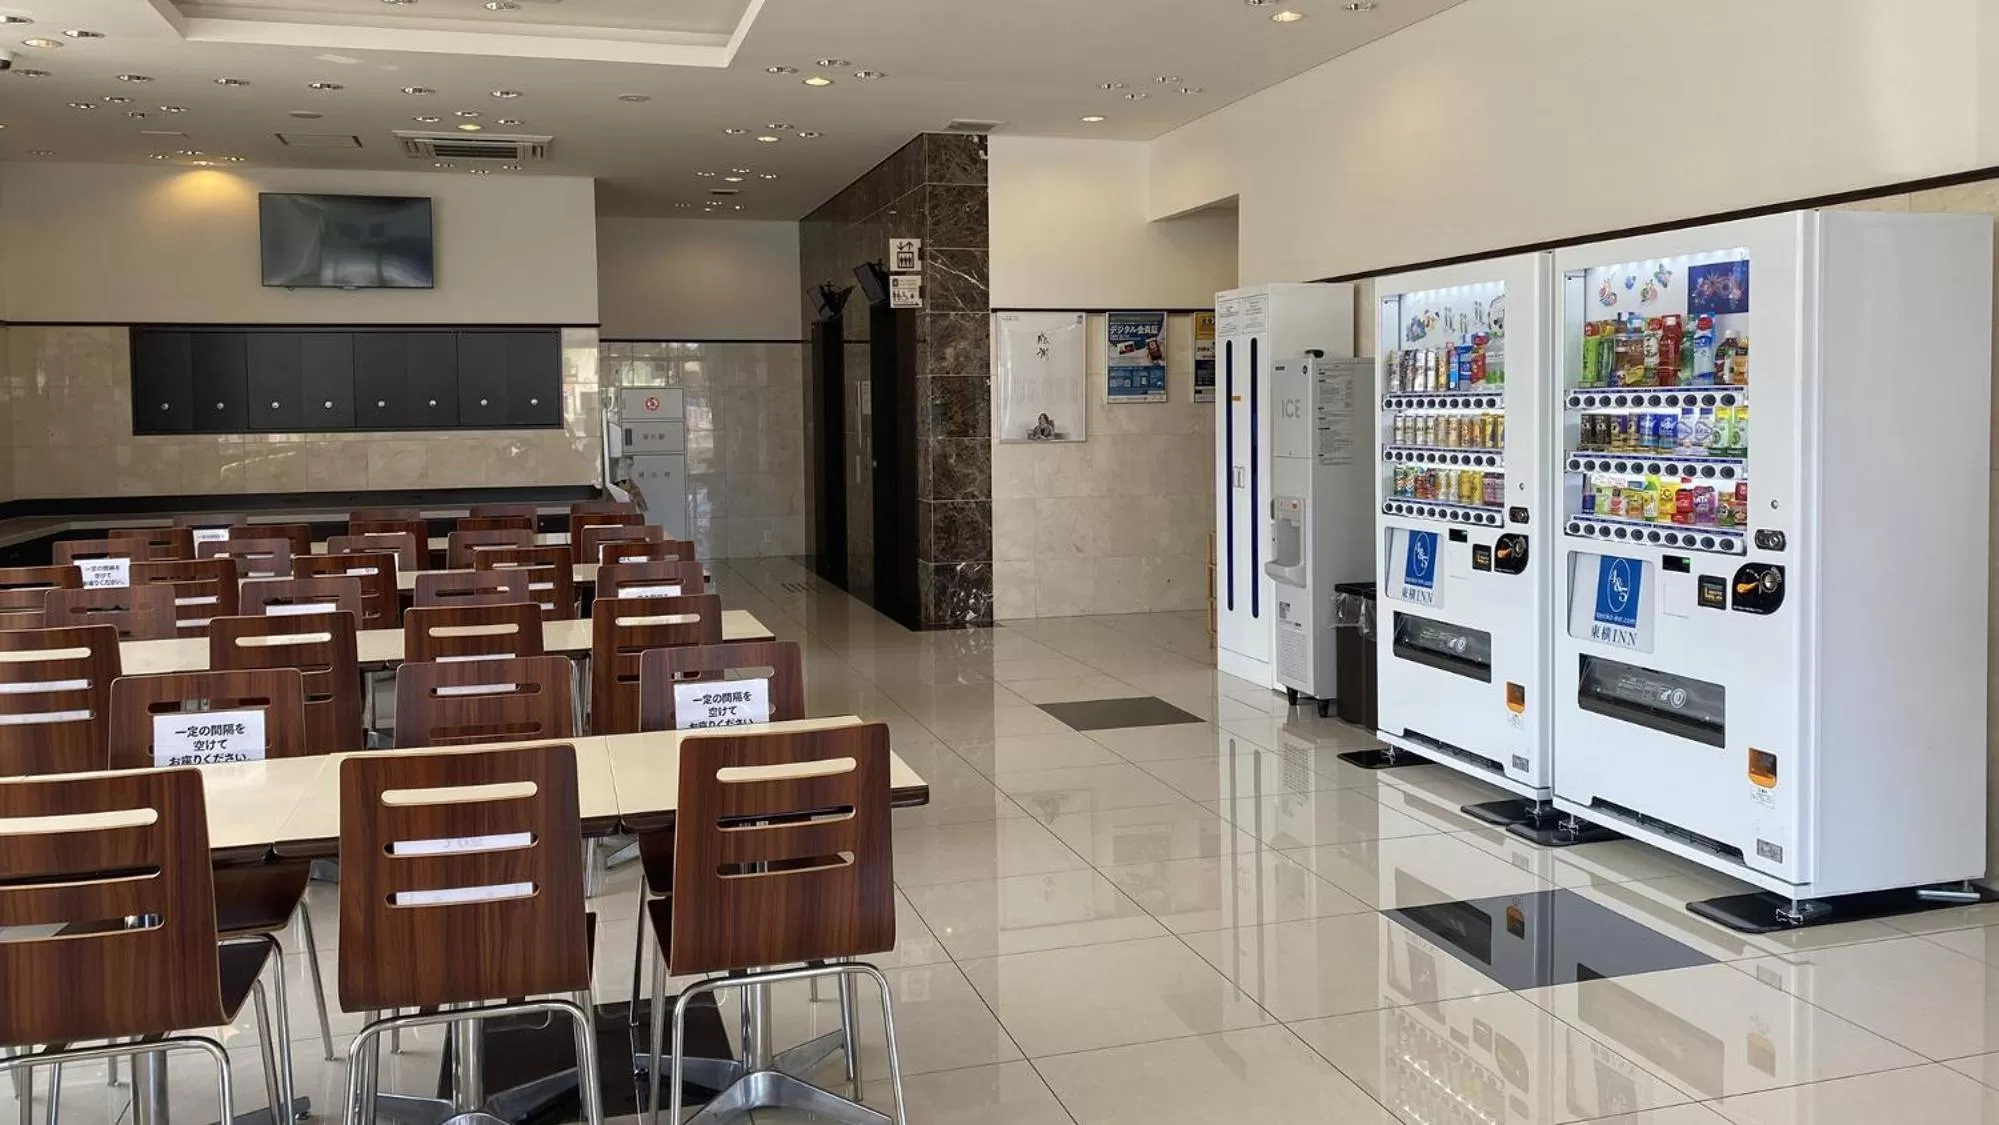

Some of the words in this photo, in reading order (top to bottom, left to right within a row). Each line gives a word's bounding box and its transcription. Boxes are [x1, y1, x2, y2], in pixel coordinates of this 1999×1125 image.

[1281, 399, 1301, 418] ICE
[1592, 623, 1638, 647] 東横INN
[693, 691, 753, 705] 一定の間隔を
[708, 706, 737, 717] 空けて
[175, 723, 246, 738] 一定の間隔を
[193, 739, 228, 751] 空けて
